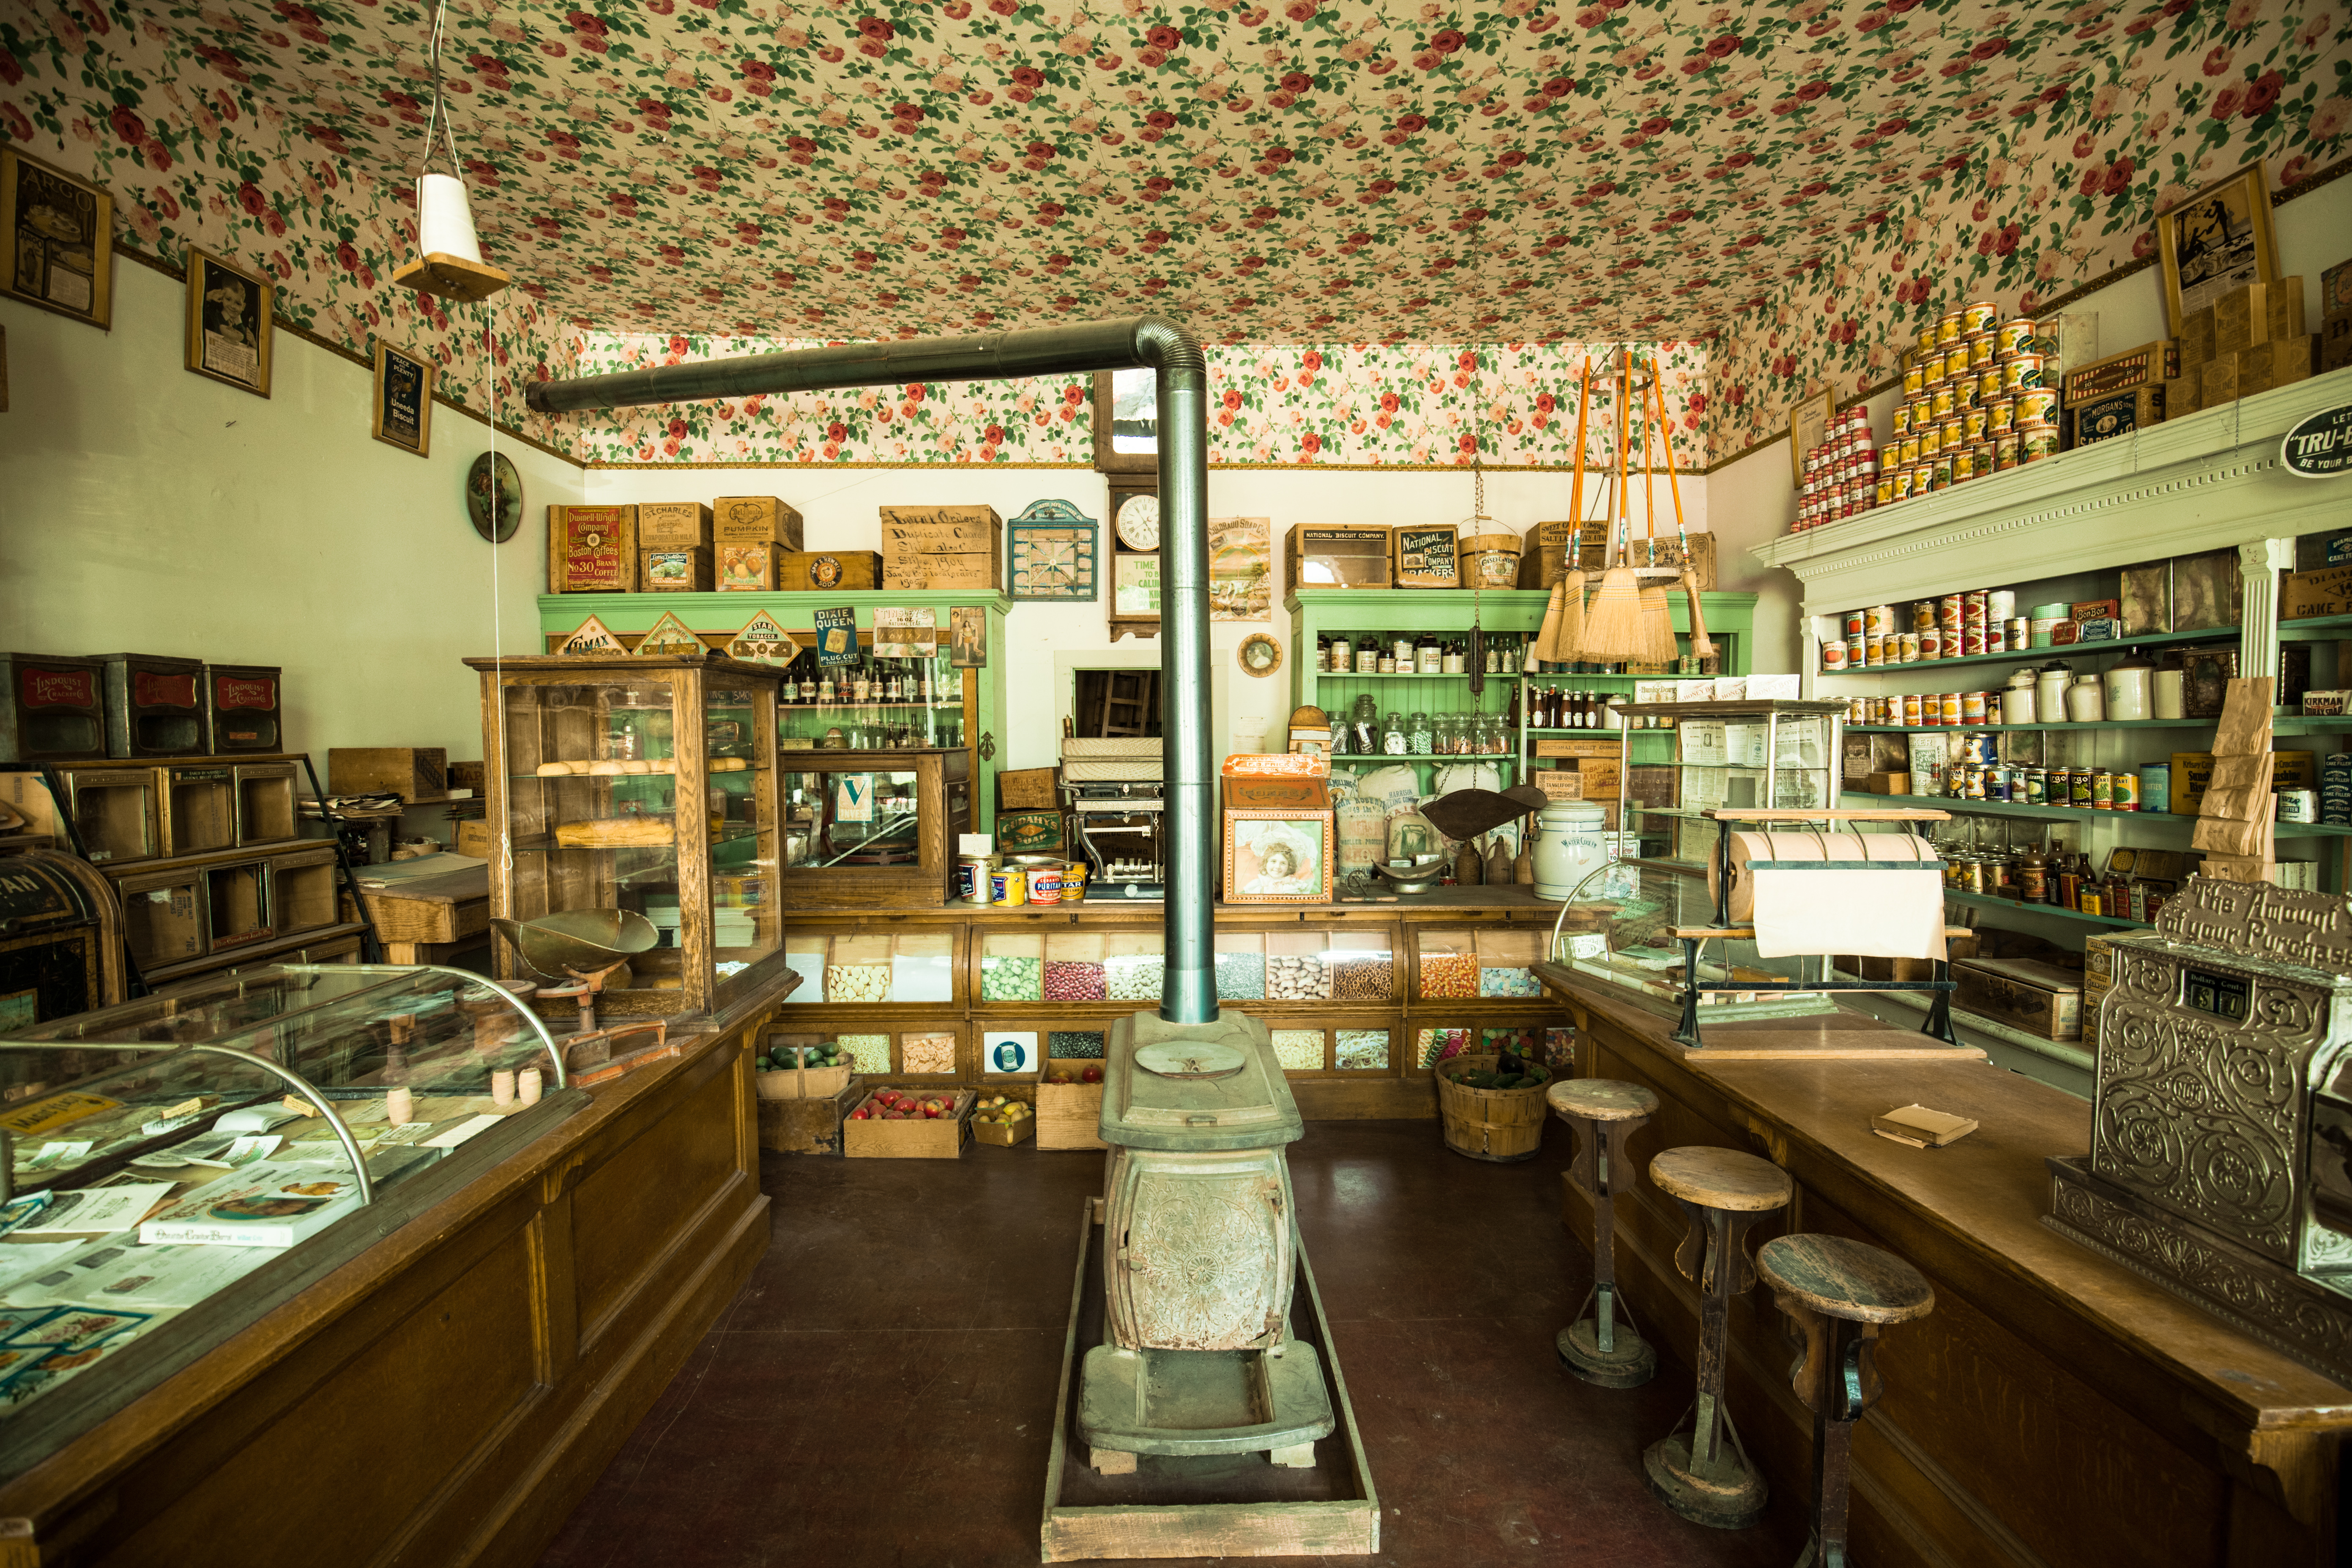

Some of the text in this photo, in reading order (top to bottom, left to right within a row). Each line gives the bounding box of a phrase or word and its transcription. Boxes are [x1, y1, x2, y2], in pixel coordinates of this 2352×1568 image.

[21, 167, 93, 211] ARGO
[19, 230, 43, 249] ARGO
[392, 355, 410, 368] PEACE
[394, 364, 414, 378] PLENTY
[391, 397, 414, 415] Uneeda
[2092, 400, 2123, 419] MORGAN'S
[393, 408, 414, 425] Biscuit
[2290, 427, 2352, 453] "TRU-B
[2300, 457, 2341, 468] BE YOUR
[569, 512, 619, 524] Dwinell-Wright
[656, 506, 693, 518] CHARLES
[888, 509, 982, 525] Local Orders
[578, 522, 609, 535] Company
[1208, 519, 1257, 536] COLORADO SOAP
[1541, 523, 1560, 534] SWEET
[889, 528, 951, 543] Duplicate
[1403, 534, 1442, 551] NATIONAL
[2333, 536, 2352, 549] DIAMO
[569, 545, 618, 558] Boston Coffees
[1424, 544, 1454, 556] BISCUIT
[651, 553, 664, 561] Long
[1424, 556, 1454, 569] COMPANY
[2328, 554, 2345, 562] CAKE
[568, 561, 594, 573] No 30
[823, 557, 841, 572] HAMMER
[1133, 561, 1156, 570] TIME
[594, 569, 618, 577] COFFEE
[818, 609, 849, 619] DIXIE
[881, 609, 929, 619] TINSLEY'S
[2077, 607, 2105, 621] Bon Bon
[2296, 602, 2336, 616] CAKE
[752, 622, 774, 632] STAR
[815, 617, 854, 630] QUEEN
[842, 652, 858, 660] CUT
[36, 677, 82, 695] LINDQUIST
[228, 684, 265, 697] LINDQUIST
[1641, 686, 1677, 695] Hunky Dory
[1753, 679, 1794, 698] HONEY BOY
[47, 687, 77, 701] CRACKER
[237, 693, 260, 703] CRACKER
[1683, 688, 1704, 700] HONEY
[2304, 697, 2344, 706] KIRKMAN
[2325, 706, 2343, 716] SOAP
[1389, 788, 1413, 799] HARRISON
[1002, 815, 1058, 833] CUDAHY'S
[1013, 833, 1047, 845] SOAP
[1561, 837, 1597, 849] WATER COOLER
[2192, 884, 2338, 934] The Amount
[2164, 909, 2241, 944] of your
[227, 934, 249, 947] Cracker
[2090, 941, 2109, 951] SHAW'S
[2090, 973, 2108, 983] WHEAT
[2191, 973, 2244, 992] Dollars Cents
[2177, 1081, 2203, 1100] NCR
